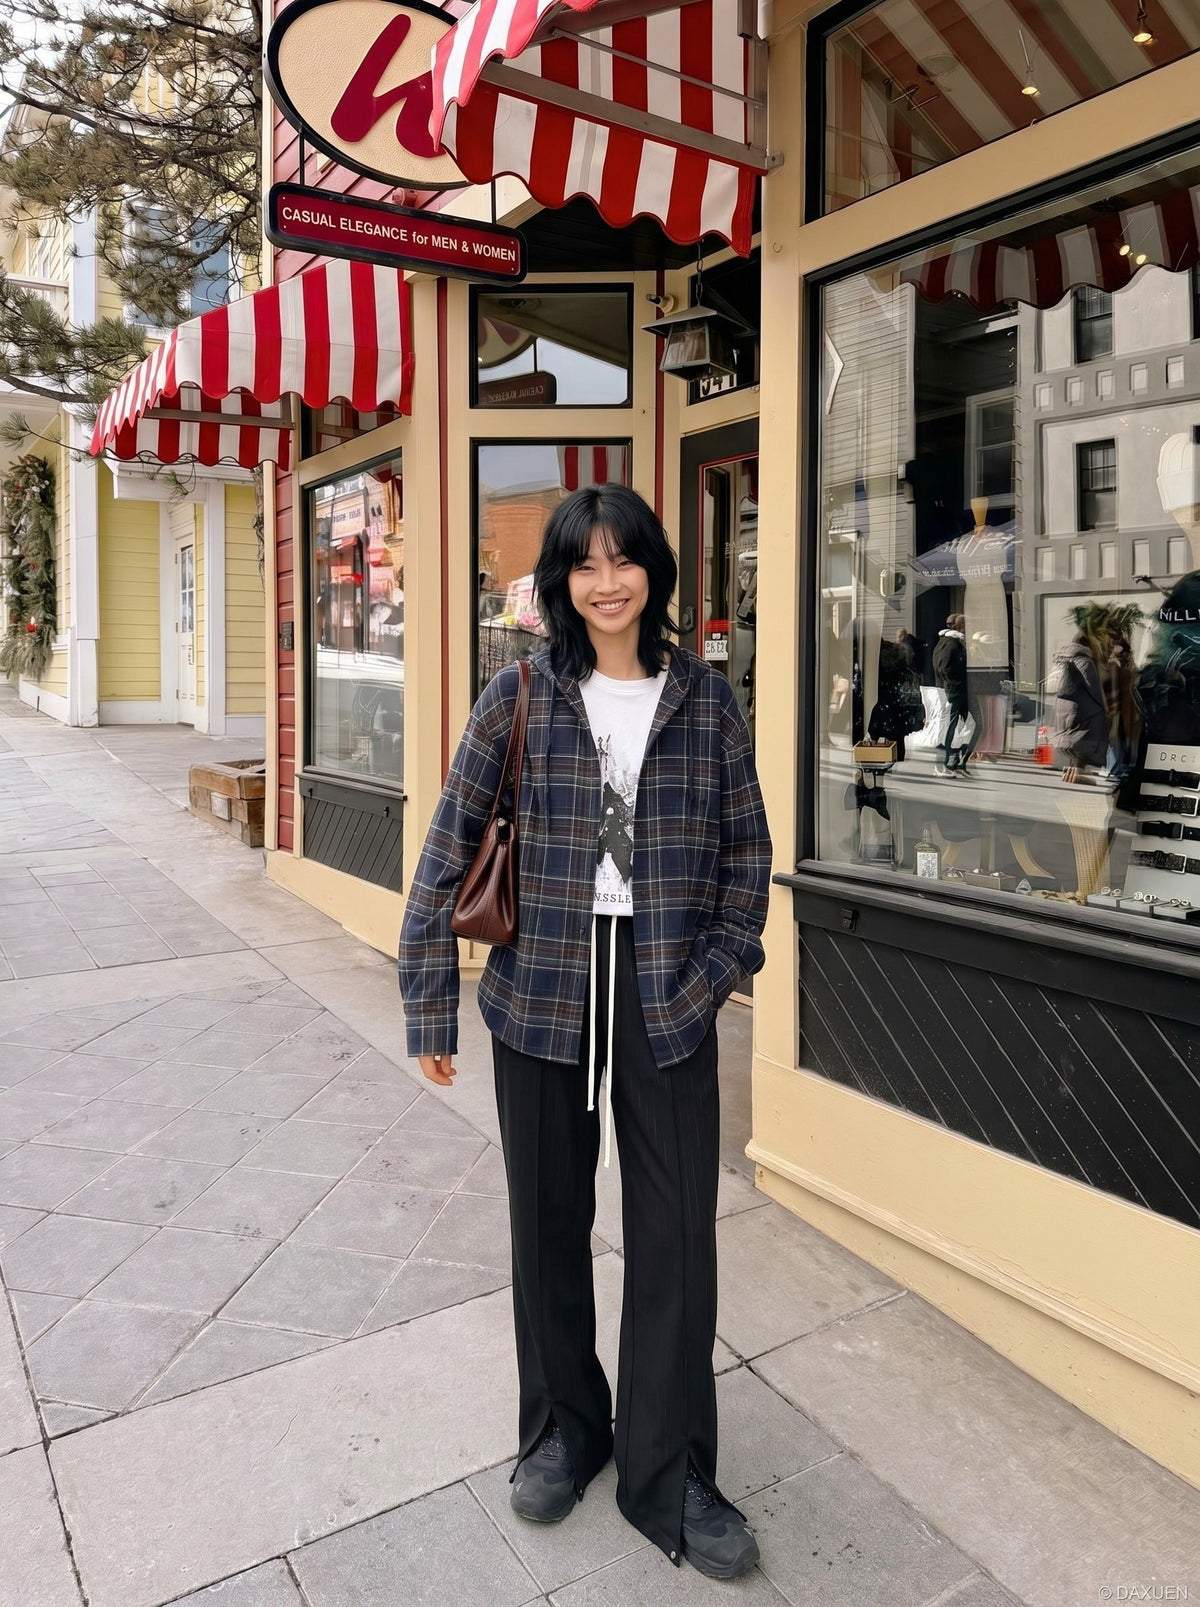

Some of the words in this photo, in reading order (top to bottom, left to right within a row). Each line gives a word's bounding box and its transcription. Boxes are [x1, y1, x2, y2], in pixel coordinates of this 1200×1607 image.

[282, 206, 336, 228] CASUAL
[339, 217, 408, 242] ELEGANCE
[412, 231, 429, 245] for
[431, 234, 458, 251] MEN
[461, 240, 470, 253] &
[472, 242, 516, 262] WOMEN
